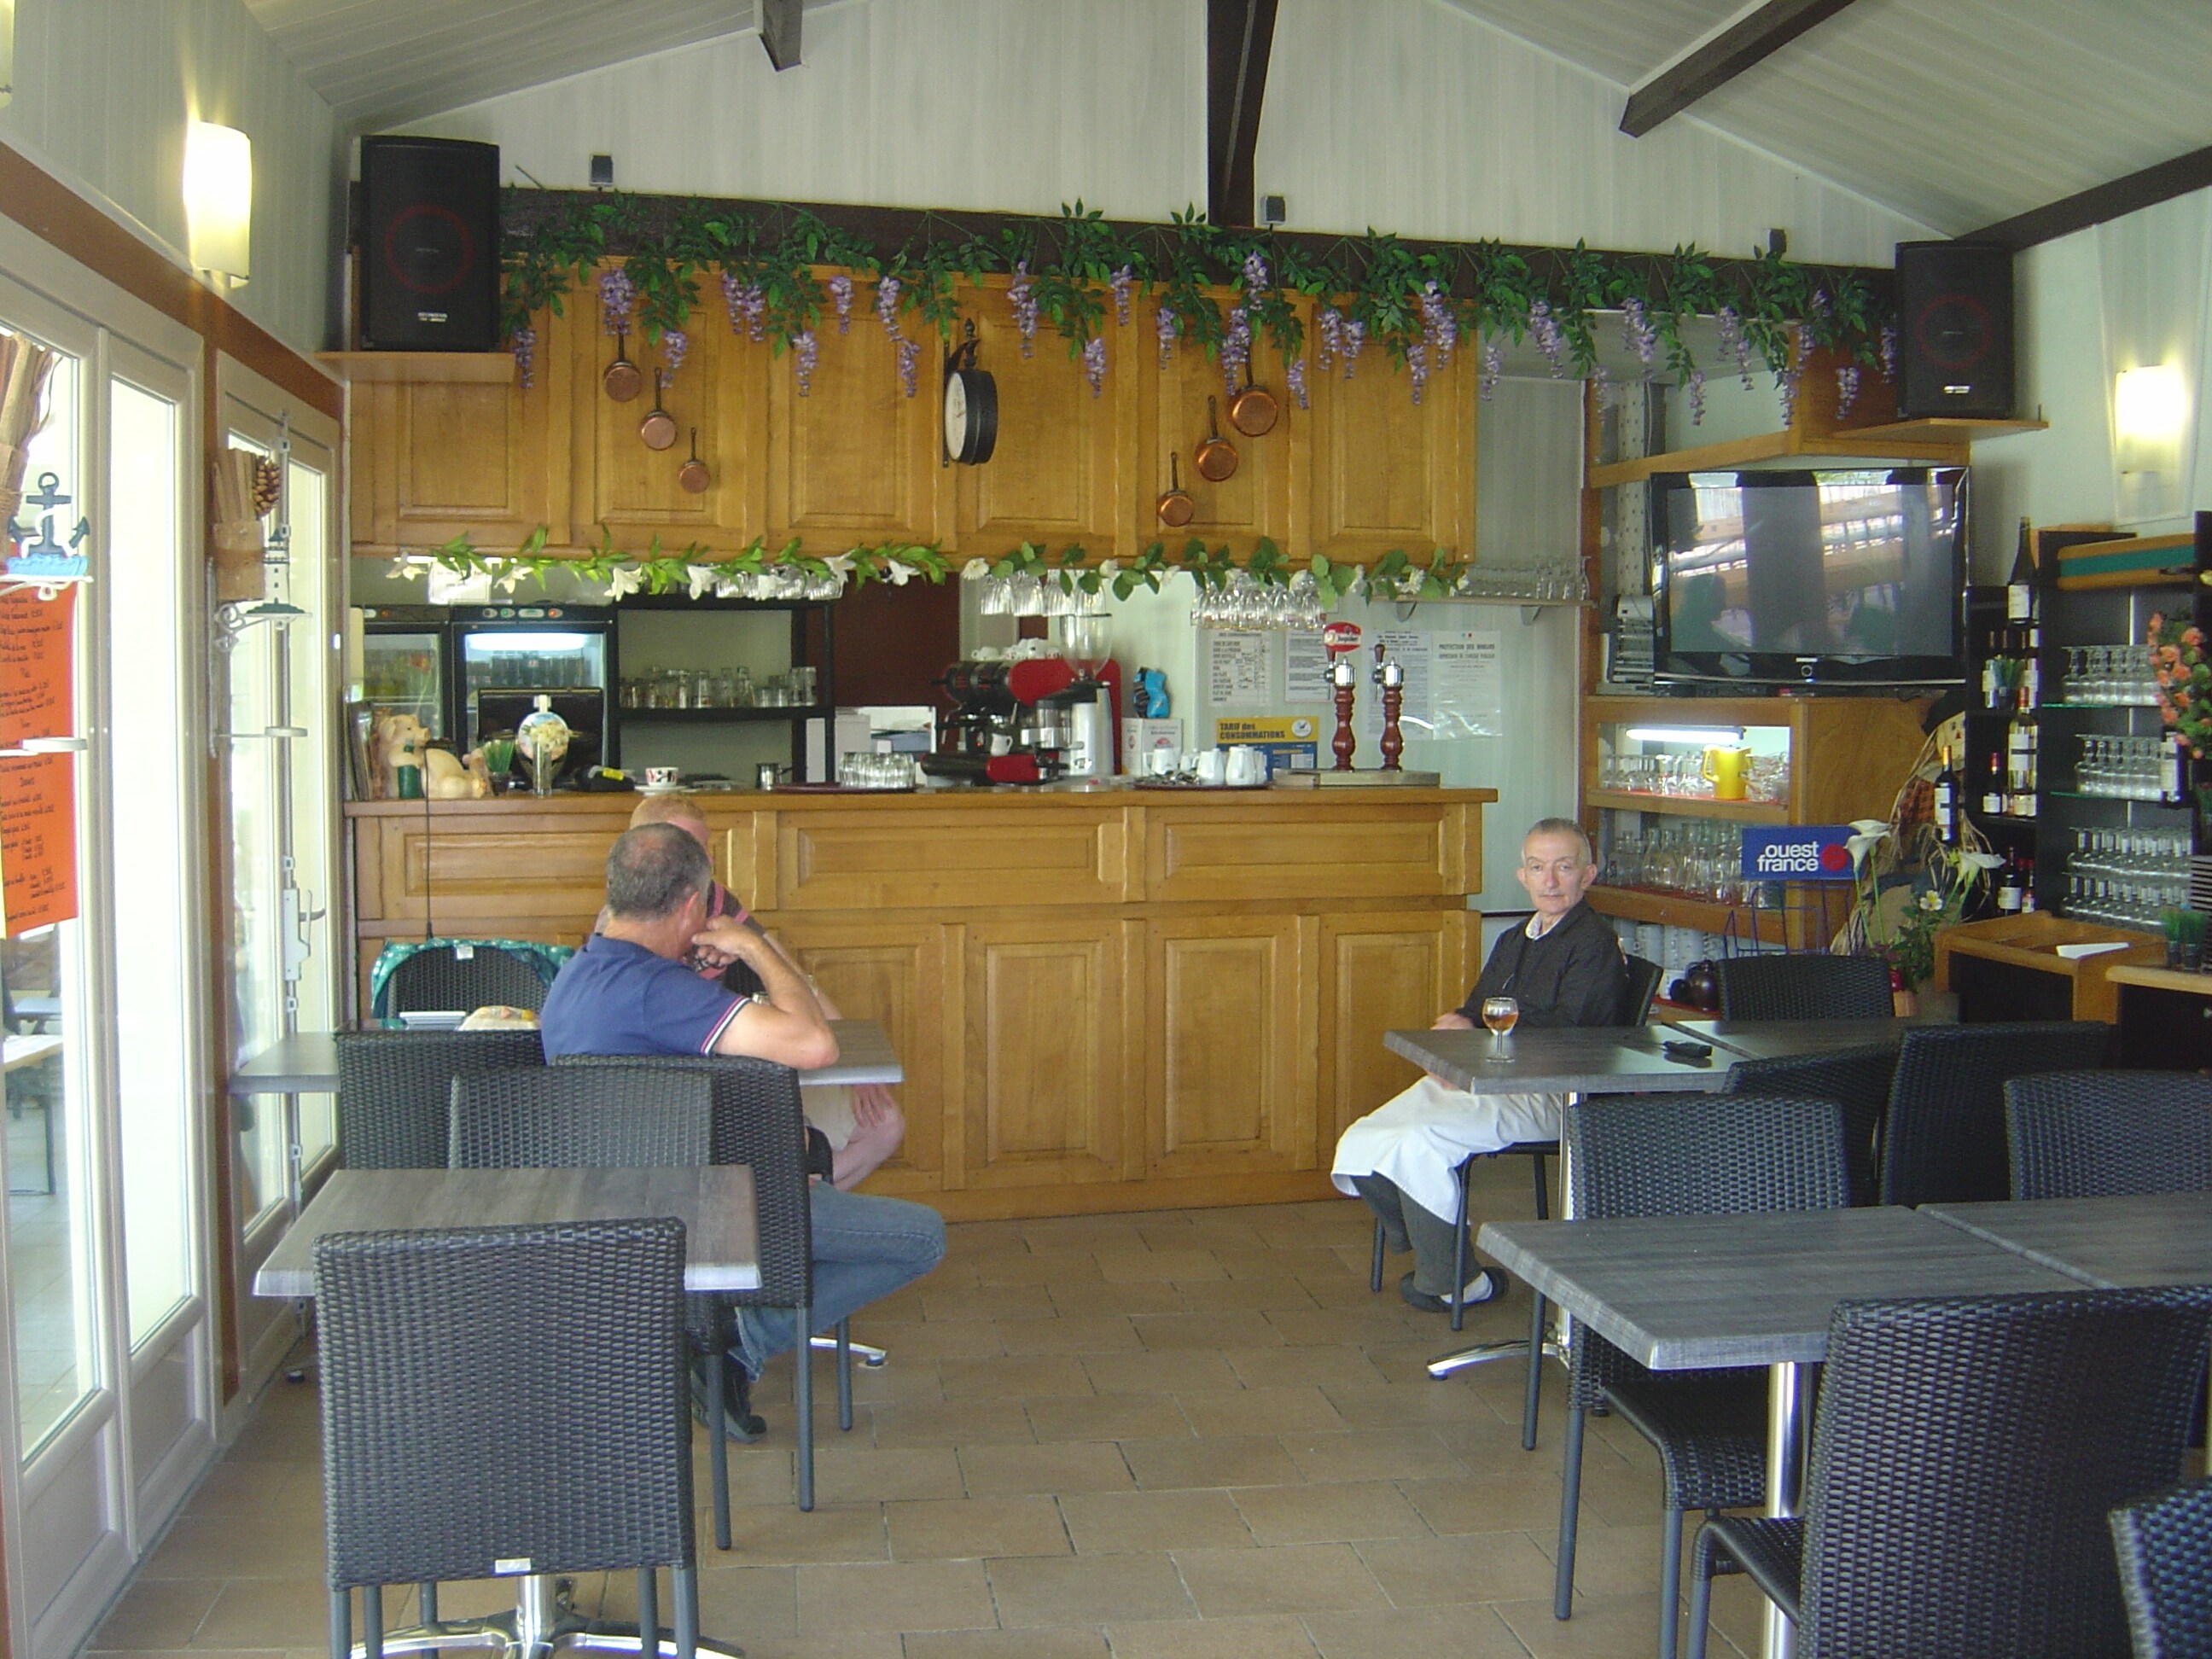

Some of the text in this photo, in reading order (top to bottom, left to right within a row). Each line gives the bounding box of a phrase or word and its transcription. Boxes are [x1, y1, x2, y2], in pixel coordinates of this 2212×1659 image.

[1220, 731, 1285, 740] CONSOMMATIONS
[1765, 841, 1819, 858] ouest
[1757, 855, 1819, 871] france
